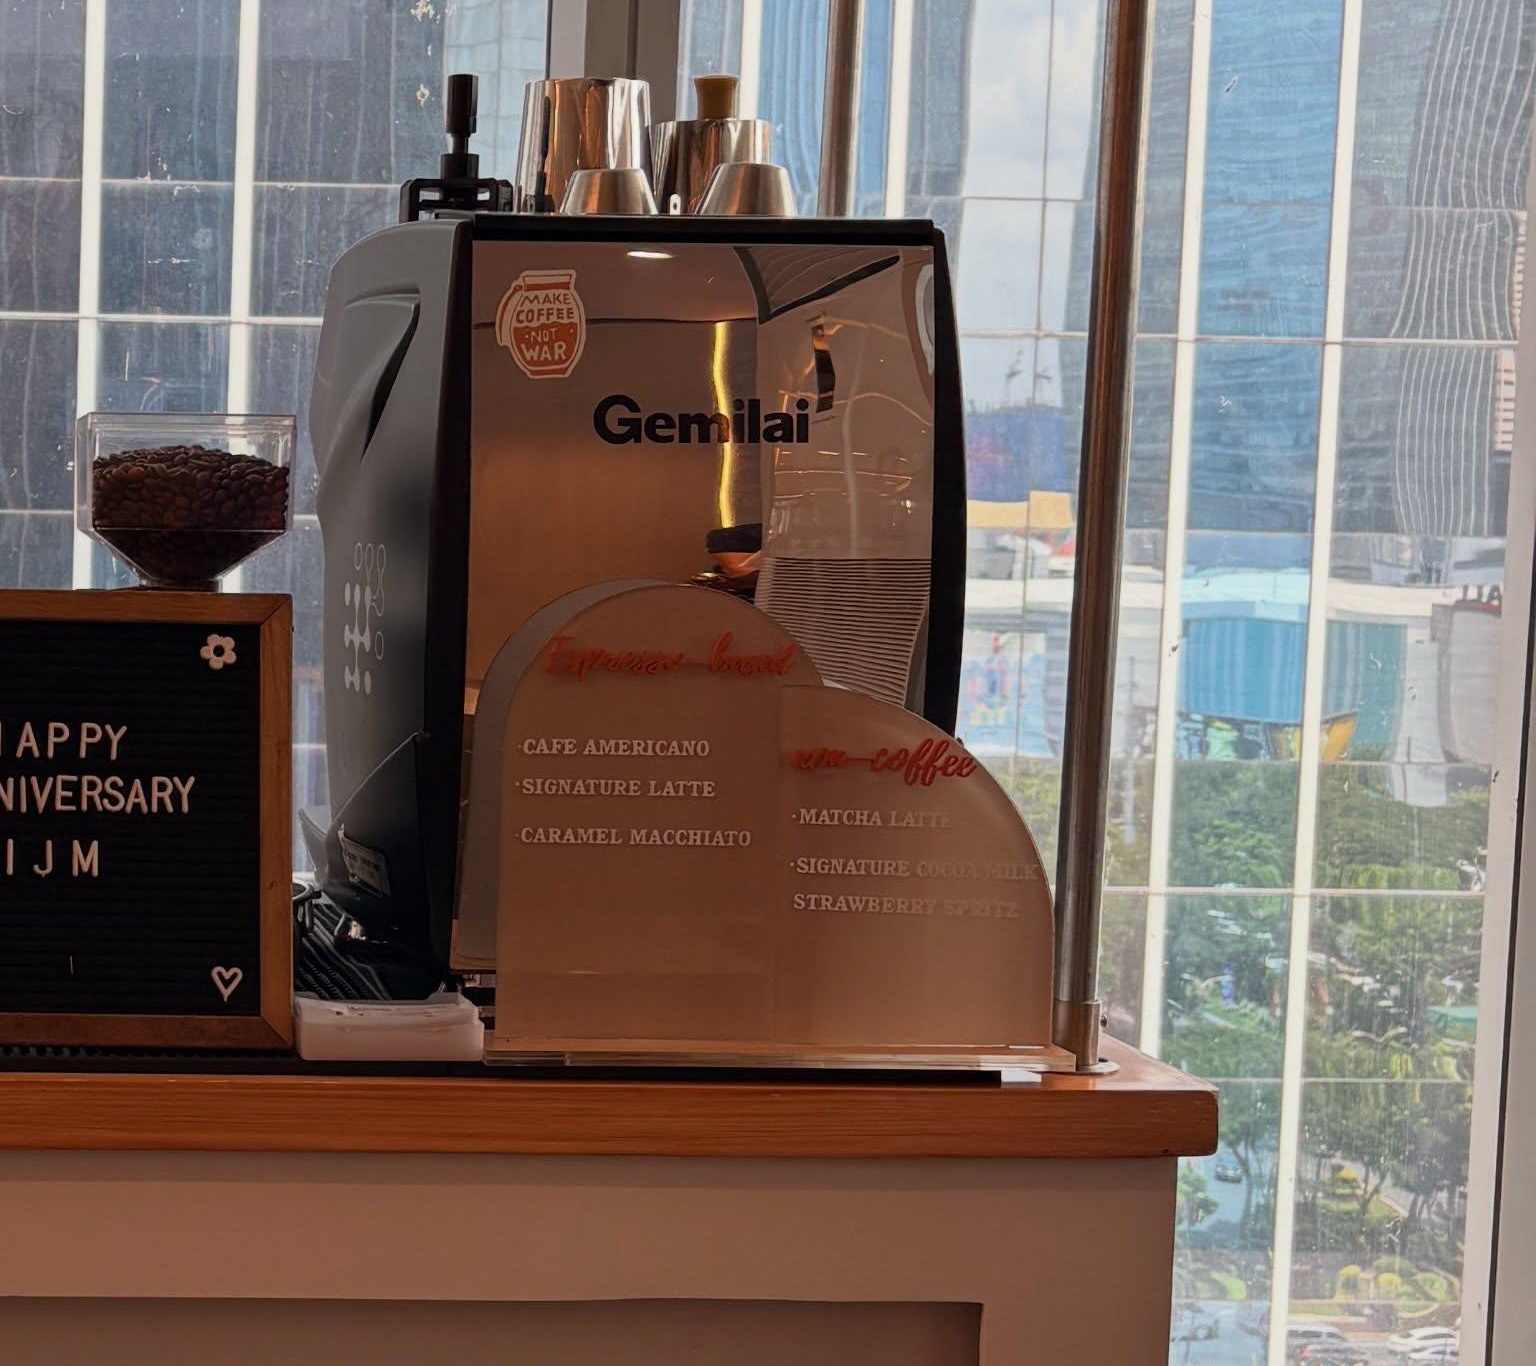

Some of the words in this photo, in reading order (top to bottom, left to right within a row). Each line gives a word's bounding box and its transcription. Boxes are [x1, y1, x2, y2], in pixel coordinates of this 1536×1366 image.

[521, 292, 571, 308] MAKE
[515, 307, 575, 324] COFFEE
[530, 327, 558, 344] NOT
[520, 342, 567, 361] WAR
[593, 393, 811, 446] Gemilai
[523, 738, 576, 755] CAFE
[583, 738, 710, 757] AMERICANO
[521, 778, 641, 796] SIGNATURE
[647, 779, 716, 798] LATTE
[799, 807, 882, 827] MATCHA
[520, 827, 623, 845] CARAMEL
[630, 828, 752, 847] MACCHIATO
[795, 857, 911, 877] SIGNATURE
[793, 893, 937, 915] STRAWBERRY
